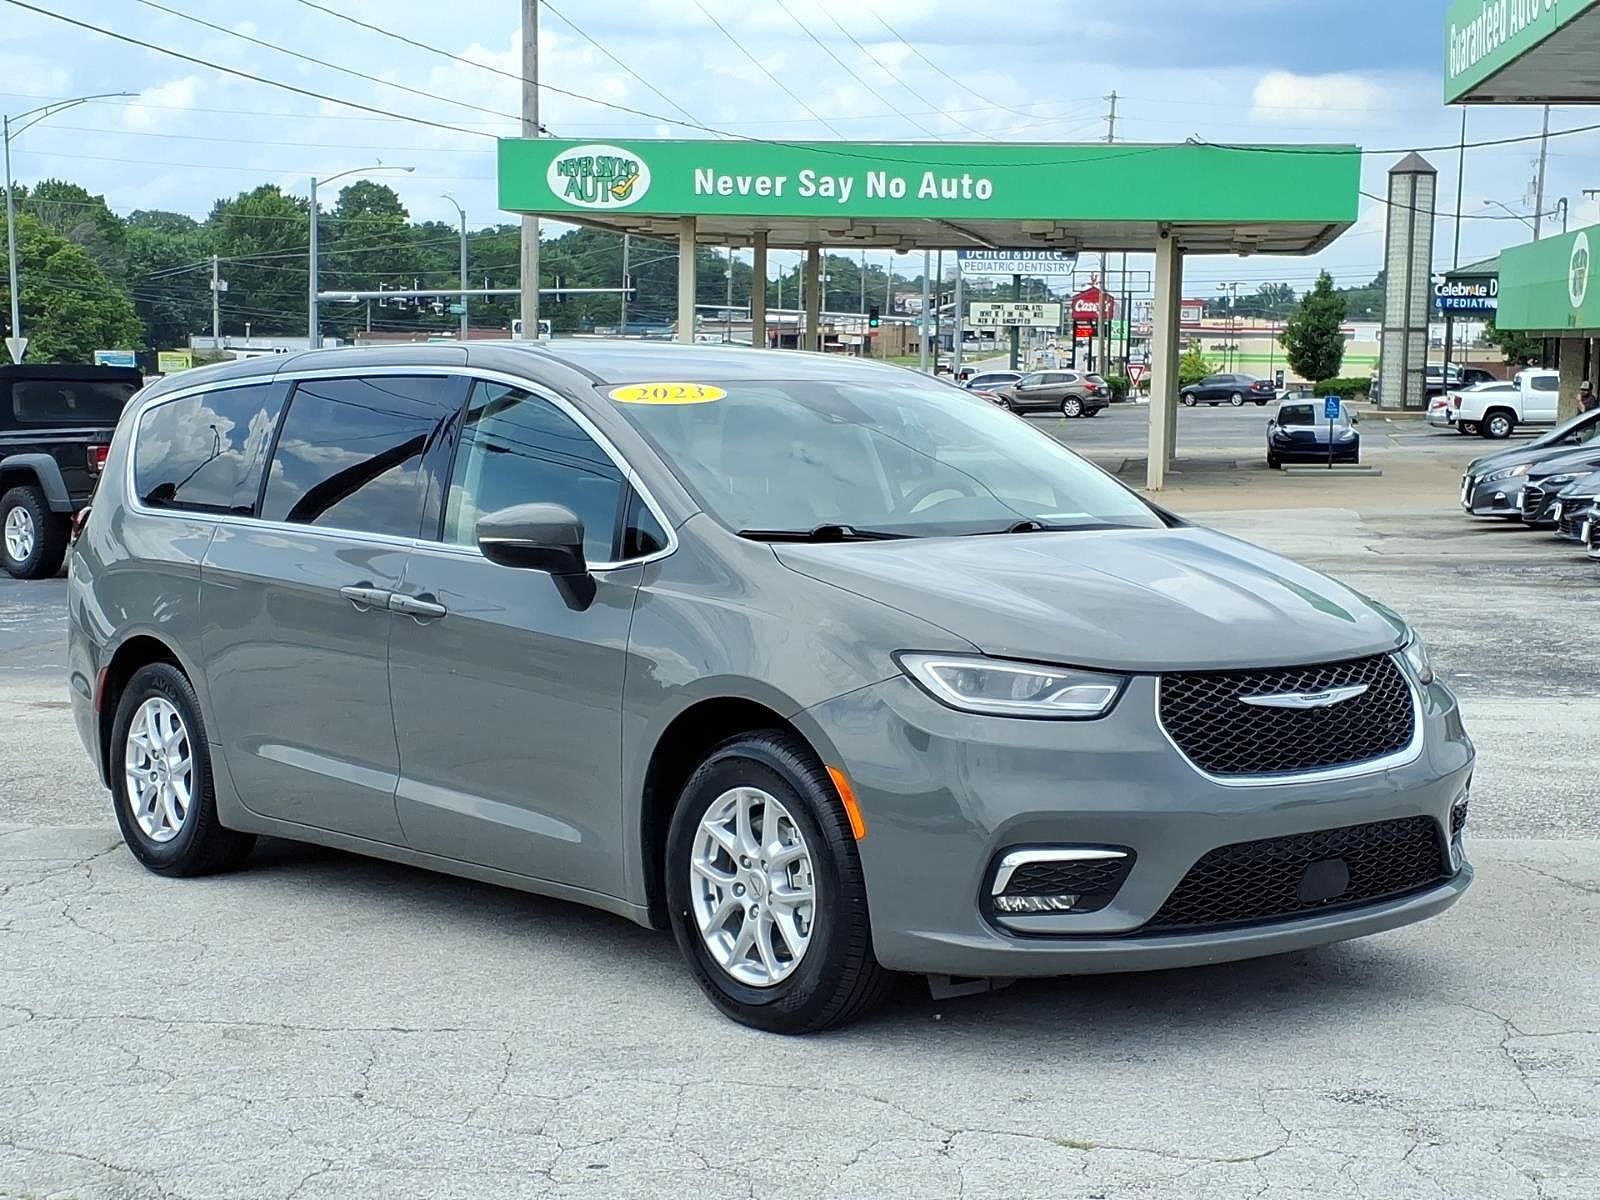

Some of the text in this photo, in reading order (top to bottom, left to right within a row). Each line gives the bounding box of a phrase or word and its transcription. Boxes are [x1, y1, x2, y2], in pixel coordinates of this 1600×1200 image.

[1450, 0, 1506, 79] Guaranteed
[557, 155, 640, 177] NEVER SAY NO
[564, 175, 634, 203] AUTO
[694, 168, 993, 204] Never Say No Auto
[1023, 250, 1068, 260] Brace
[964, 261, 1072, 273] PEDIATRIC DENTISTRY
[1075, 299, 1111, 315] Case's
[1446, 298, 1493, 309] PEDIATR
[636, 386, 705, 400] 2023
